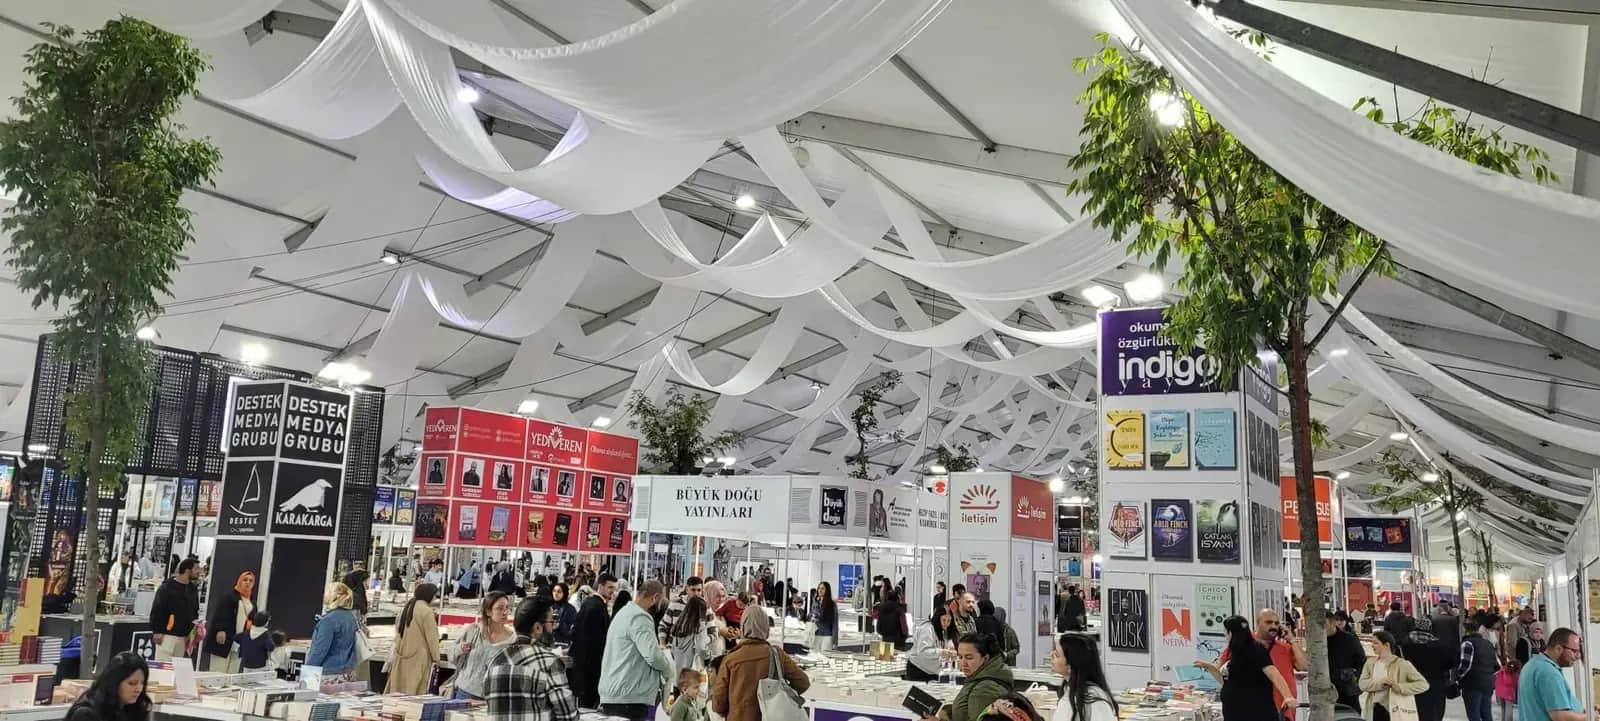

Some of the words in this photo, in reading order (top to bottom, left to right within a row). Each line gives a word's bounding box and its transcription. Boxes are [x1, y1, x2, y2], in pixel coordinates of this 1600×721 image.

[1118, 350, 1216, 387] indigo
[236, 394, 283, 411] DESTEK
[288, 396, 348, 419] DESTEK
[234, 412, 279, 429] MEDYA
[286, 414, 345, 438] MEDYA
[232, 431, 279, 447] GRUBU
[284, 433, 344, 454] GRUBU
[676, 485, 721, 502] BÜYÜK
[724, 487, 763, 503] DOĞU
[684, 505, 753, 519] YAYINLARI
[1283, 500, 1330, 517] PESUS
[229, 516, 258, 525] DESTEK
[275, 511, 333, 528] KARAKARGA
[961, 513, 997, 526] iletişim
[1111, 620, 1145, 650] MUSK
